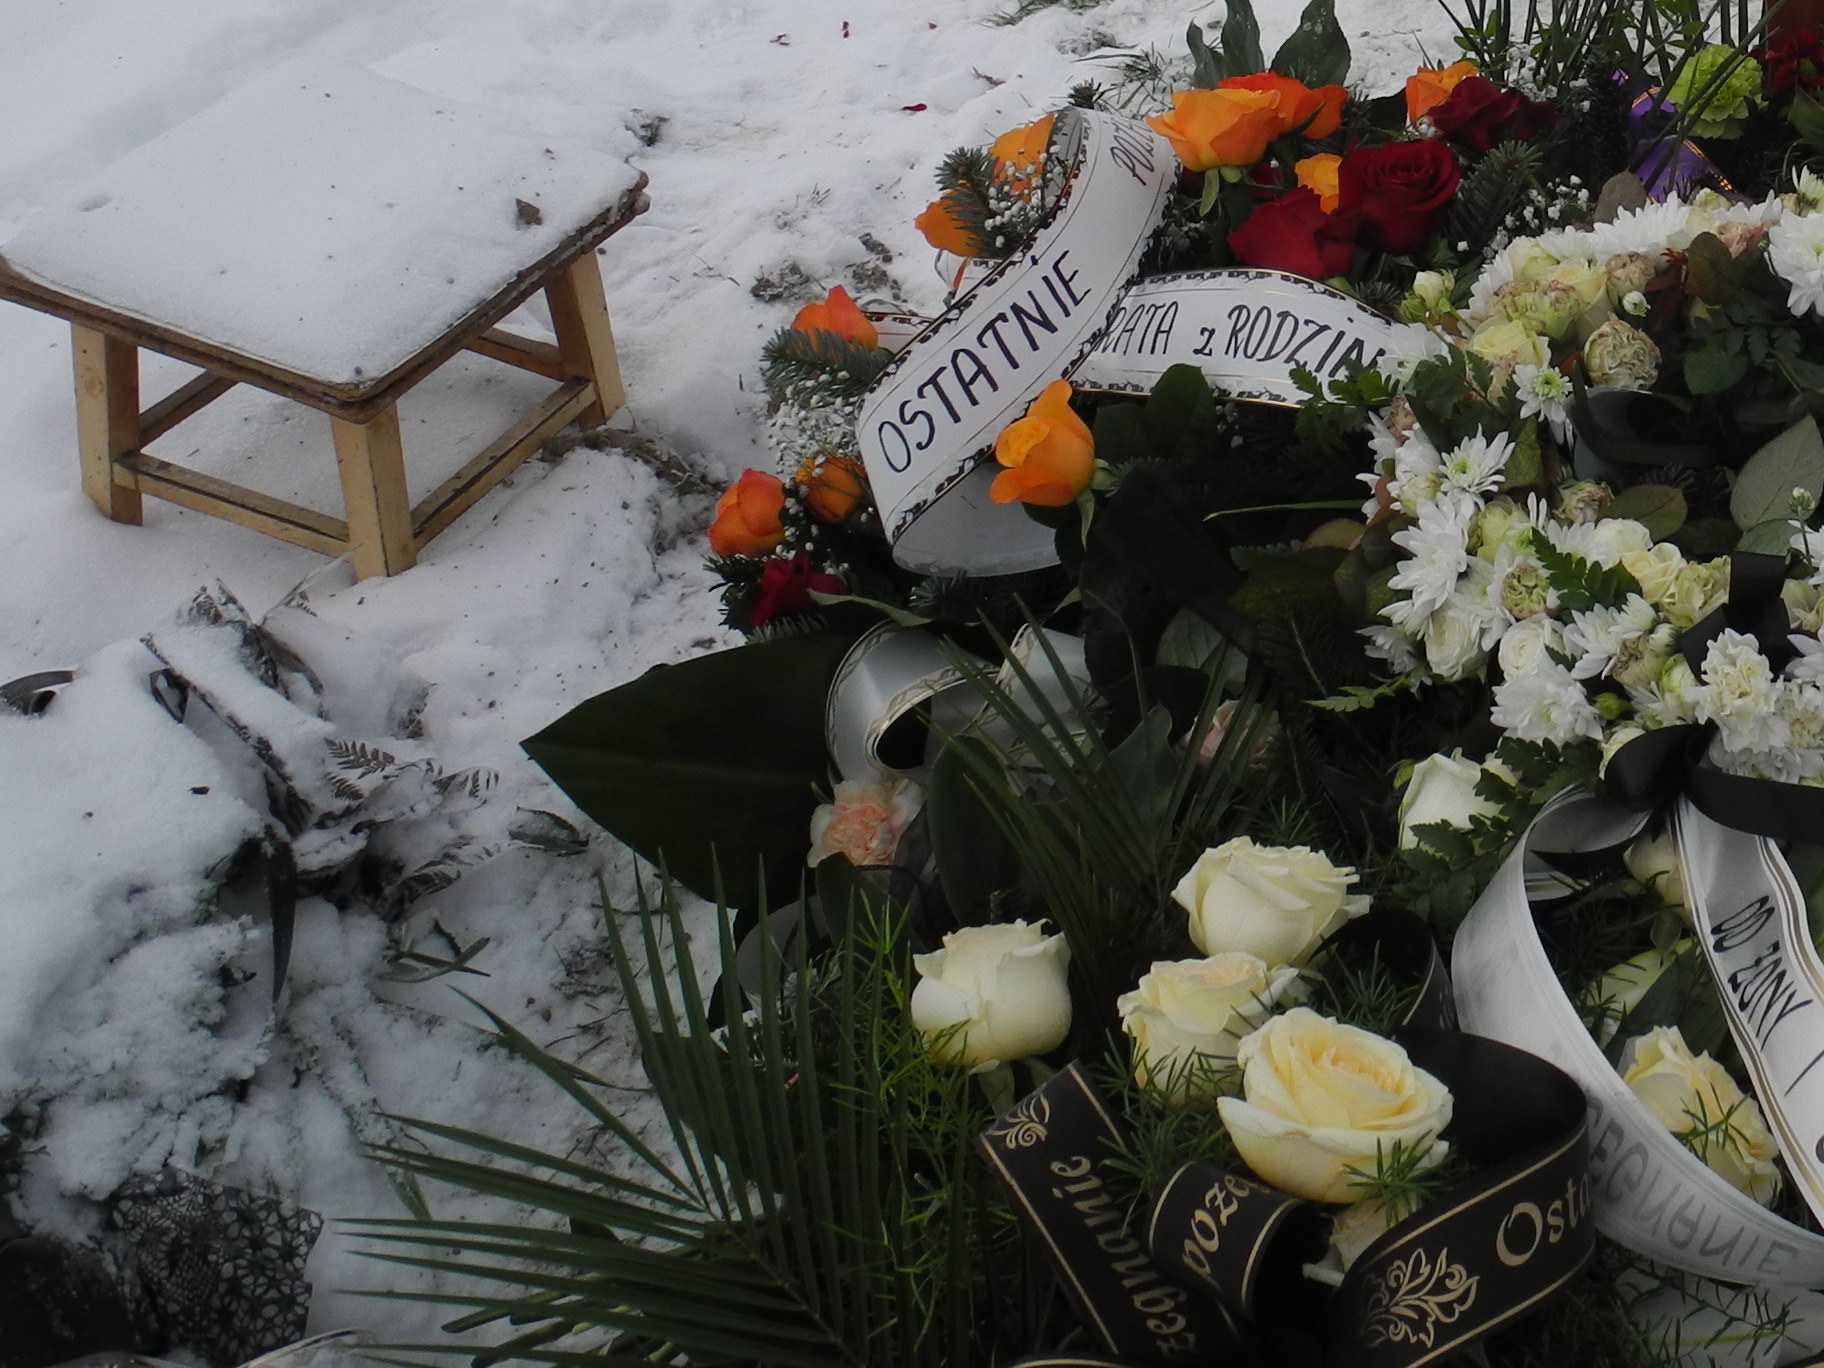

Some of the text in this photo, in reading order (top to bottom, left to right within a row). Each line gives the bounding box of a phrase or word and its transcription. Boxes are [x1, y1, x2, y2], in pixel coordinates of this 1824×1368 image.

[878, 249, 1092, 474] OSTATNIE
[1101, 300, 1180, 356] RATA
[1224, 302, 1388, 379] RODZIN
